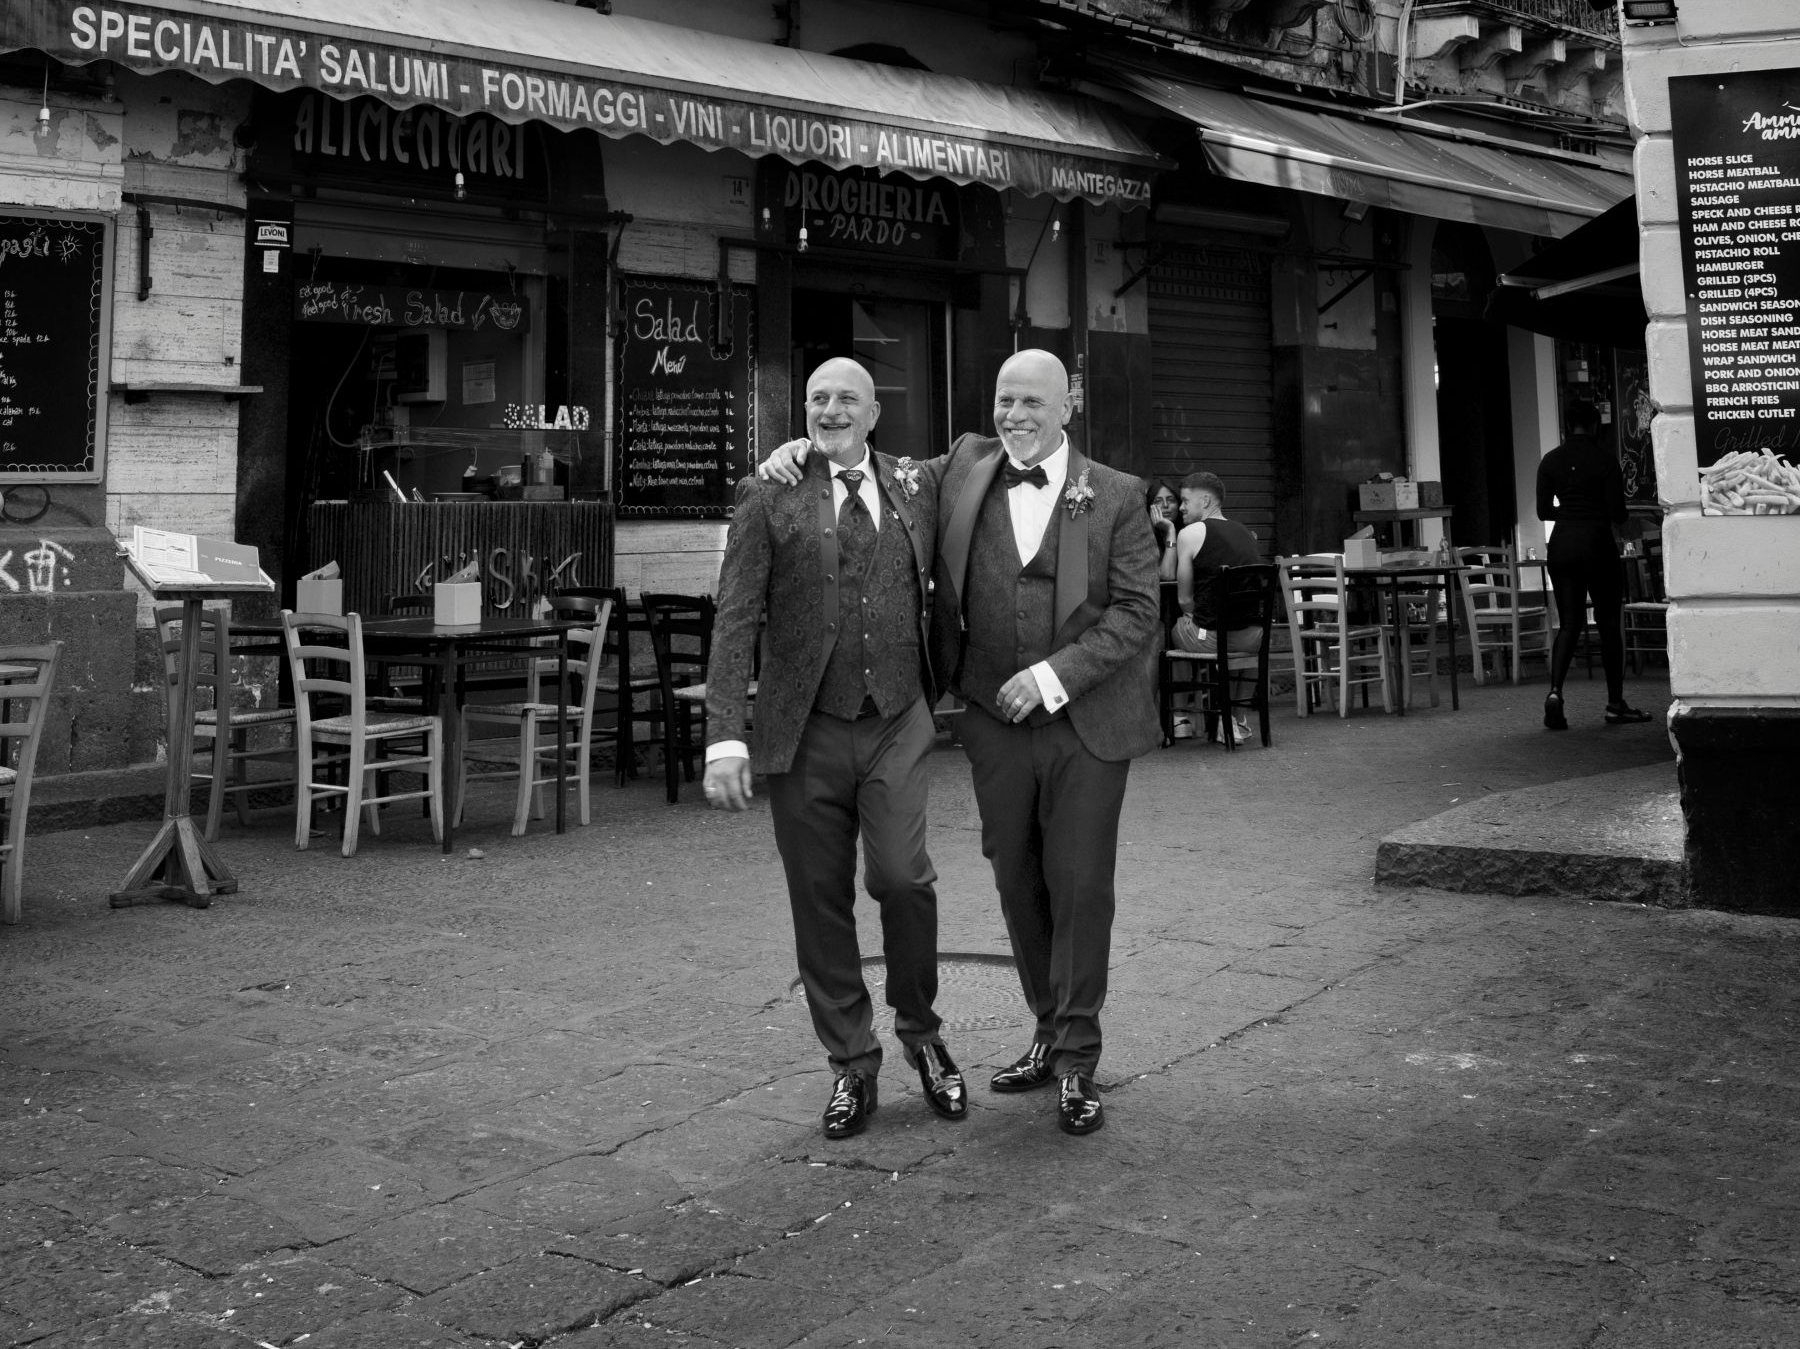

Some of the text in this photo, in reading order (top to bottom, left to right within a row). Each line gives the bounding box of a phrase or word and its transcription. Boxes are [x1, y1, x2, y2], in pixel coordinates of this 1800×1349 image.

[70, 6, 306, 79] SPECIALITA'
[320, 44, 449, 100] SALUMI
[482, 68, 647, 130] FORMAGGI
[669, 97, 724, 140] VINI
[749, 113, 852, 159] LIQUORI
[876, 131, 1012, 181] ALIMENTARI
[1051, 166, 1152, 201] MANTEGAZZA
[293, 92, 525, 180] ALIMENTARI
[1687, 154, 1754, 167] HORSE SLICE
[1688, 166, 1781, 180] HORSE MEATBALL
[1689, 181, 1746, 193] PISTACHIO
[783, 170, 951, 226] DROGHERIA
[1690, 195, 1740, 206] SAUSAGE
[1691, 208, 1725, 219] SPECK
[1726, 207, 1752, 217] AND
[1753, 205, 1793, 216] CHEESE
[260, 227, 285, 238] LEVONI
[829, 212, 907, 246] PARDO
[1692, 222, 1719, 233] HAM
[1720, 221, 1746, 231] AND
[1747, 219, 1787, 230] CHEESE
[1693, 235, 1734, 247] OLIVES,
[1736, 233, 1779, 245] ONION,
[1695, 247, 1781, 258] PISTACHIO ROLL
[1696, 260, 1765, 272] HAMBURGER
[1697, 273, 1777, 286] GRILLED (3PCS)
[1698, 287, 1778, 299] GRILLED (4PCS)
[404, 290, 465, 326] Salad
[1699, 301, 1758, 312] SANDWICH
[634, 297, 702, 342] Salad
[1700, 312, 1794, 326] DISH SEASONING
[1701, 329, 1738, 339] HORSE
[1739, 327, 1769, 338] MEAT
[1702, 342, 1739, 353] HORSE
[1740, 340, 1770, 351] MEAT
[1702, 353, 1797, 366] WRAP SANDWICH
[1704, 369, 1735, 380] PORK
[1736, 368, 1762, 379] AND
[1705, 380, 1800, 394] BBQ ARROSTICINI
[1706, 394, 1780, 407] FRENCH FRIES
[504, 403, 589, 431] SALAD
[1707, 407, 1796, 420] CHICKEN CUTLET
[1714, 424, 1787, 455] Grilled
